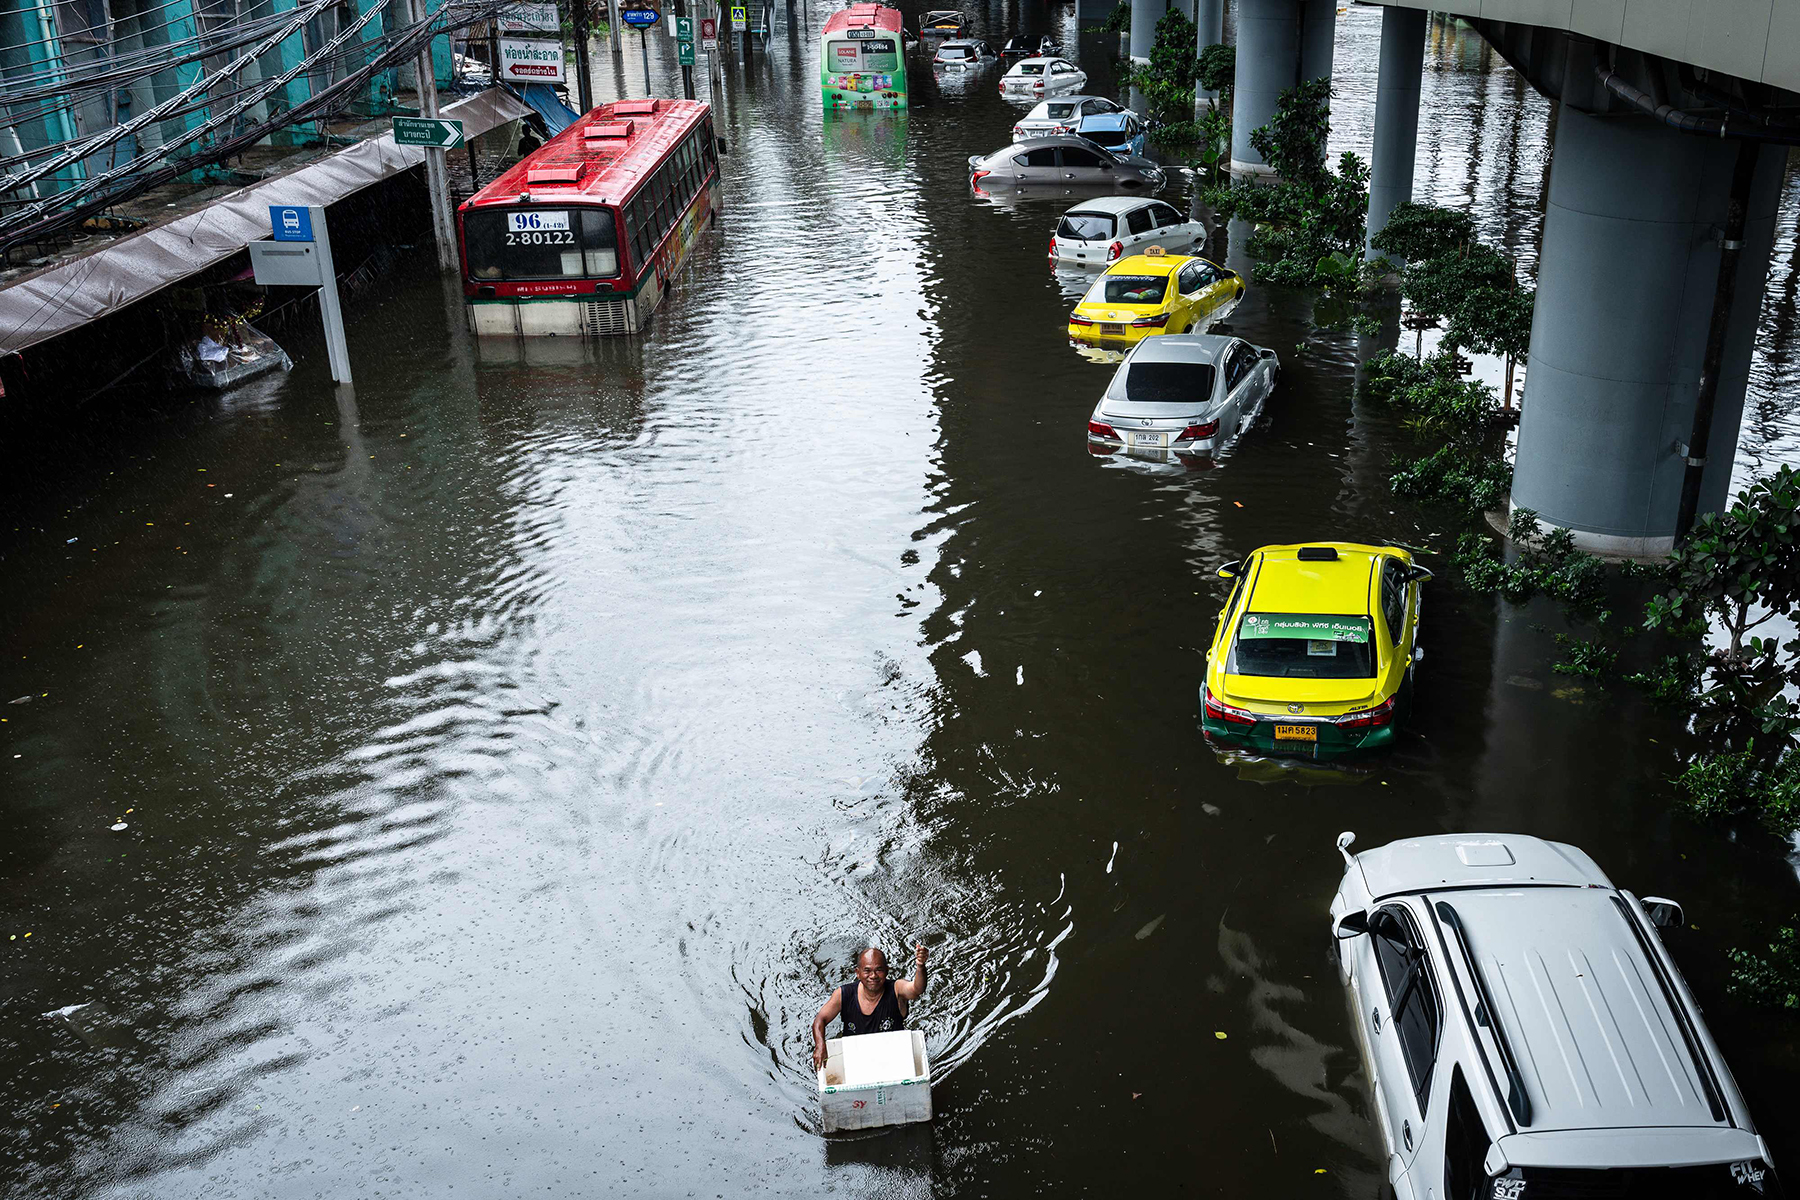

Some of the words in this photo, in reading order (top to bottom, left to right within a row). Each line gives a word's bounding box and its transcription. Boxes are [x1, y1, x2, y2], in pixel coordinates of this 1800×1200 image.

[643, 12, 655, 20] 129
[505, 44, 559, 61] ห้องน้ำสะอาด
[398, 119, 436, 129] สำนักงานเขต
[403, 129, 431, 139] บางกะปิ
[515, 213, 541, 230] 96
[505, 231, 575, 246] 2-80122
[1148, 433, 1160, 441] 202
[1295, 726, 1316, 735] 5823
[1737, 1170, 1766, 1185] WHEY
